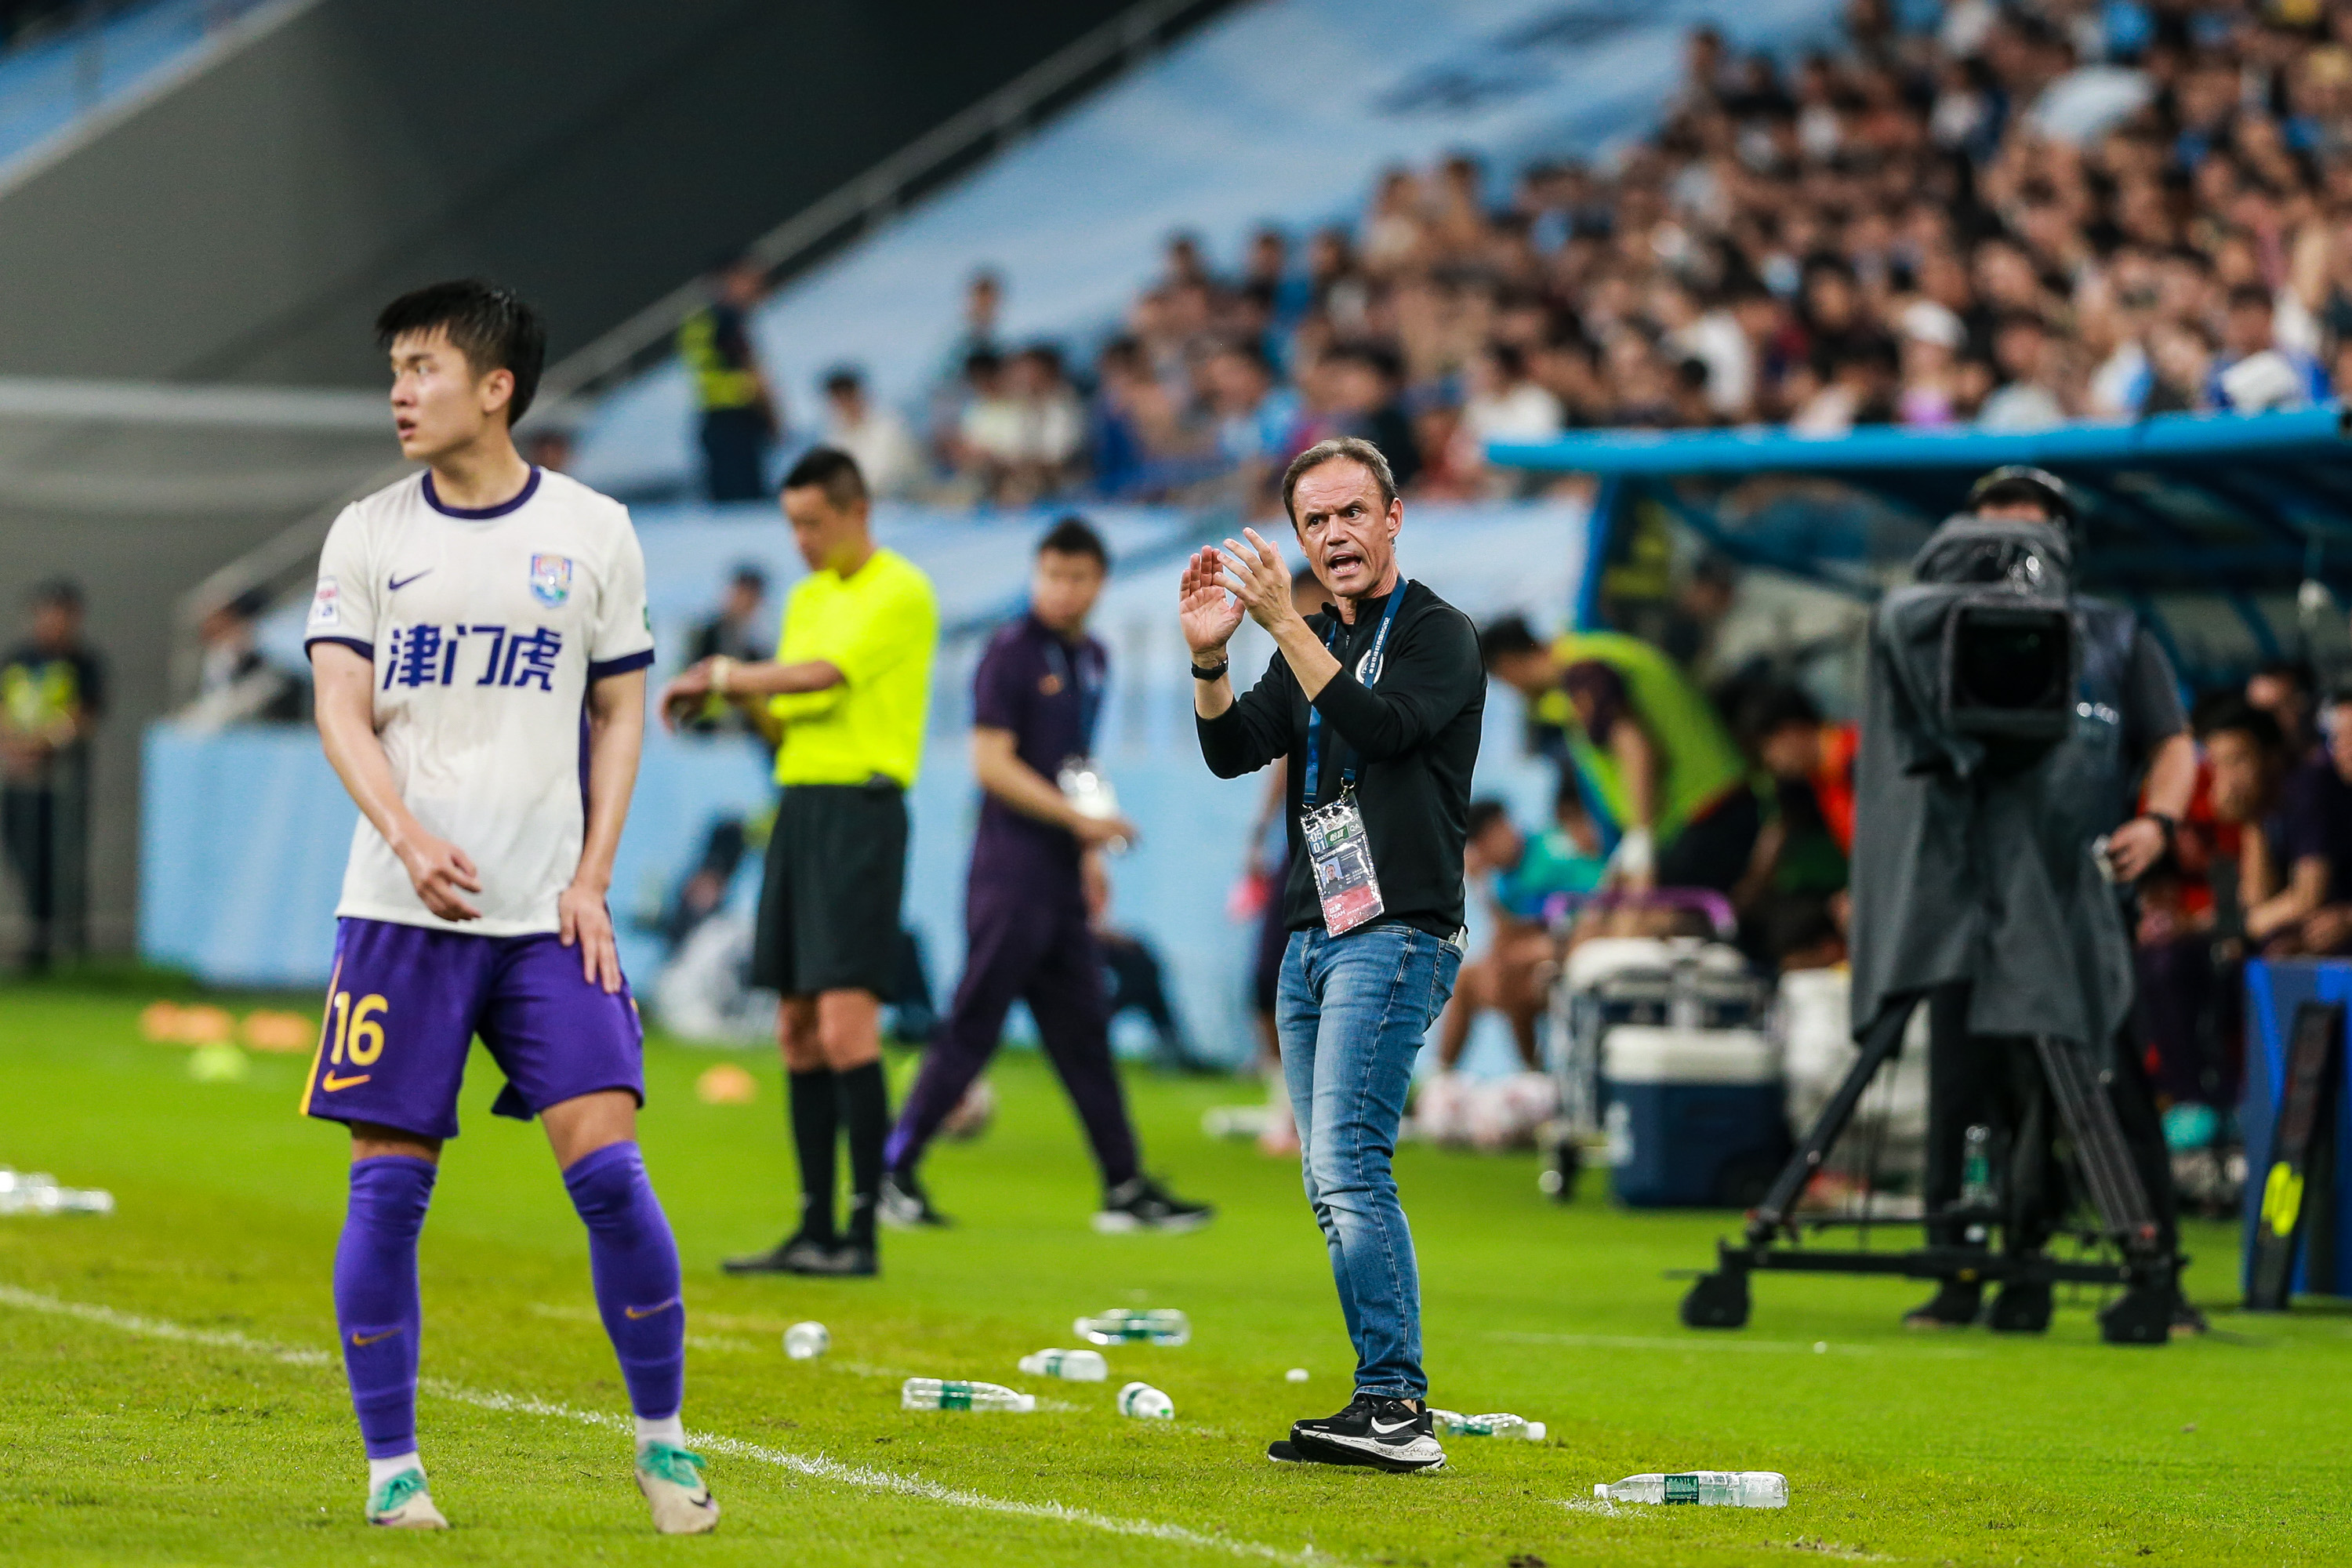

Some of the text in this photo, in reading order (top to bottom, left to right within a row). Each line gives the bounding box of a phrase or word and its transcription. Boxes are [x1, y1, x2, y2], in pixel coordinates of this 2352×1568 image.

[383, 624, 562, 691] 津门虎
[1349, 823, 1361, 832] QA
[1309, 828, 1323, 843] 05
[1312, 840, 1326, 854] 01
[1330, 909, 1346, 920] TEAM
[330, 991, 389, 1066] 16
